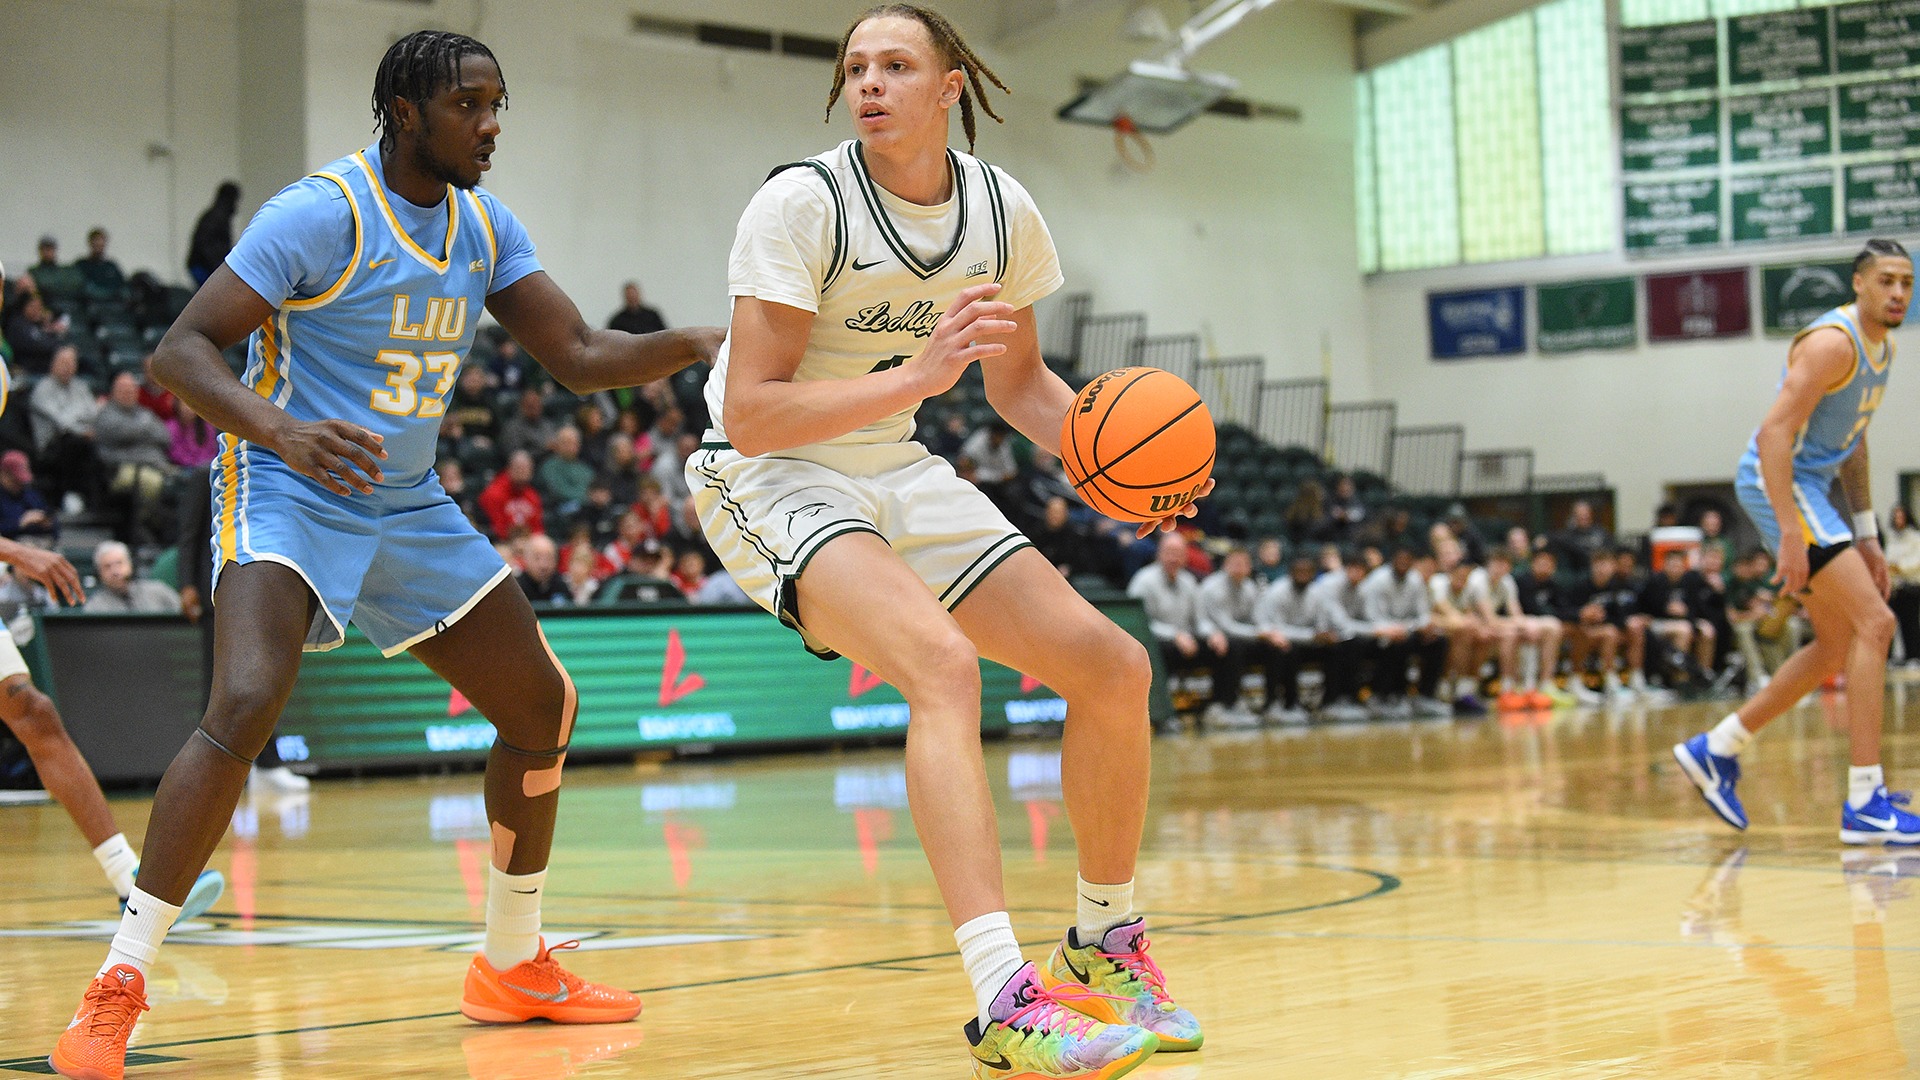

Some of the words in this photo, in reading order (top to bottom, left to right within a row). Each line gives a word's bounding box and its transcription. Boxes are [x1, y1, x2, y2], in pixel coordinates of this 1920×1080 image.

[966, 260, 988, 276] NEC
[389, 294, 467, 341] LIU
[369, 350, 460, 418] 33
